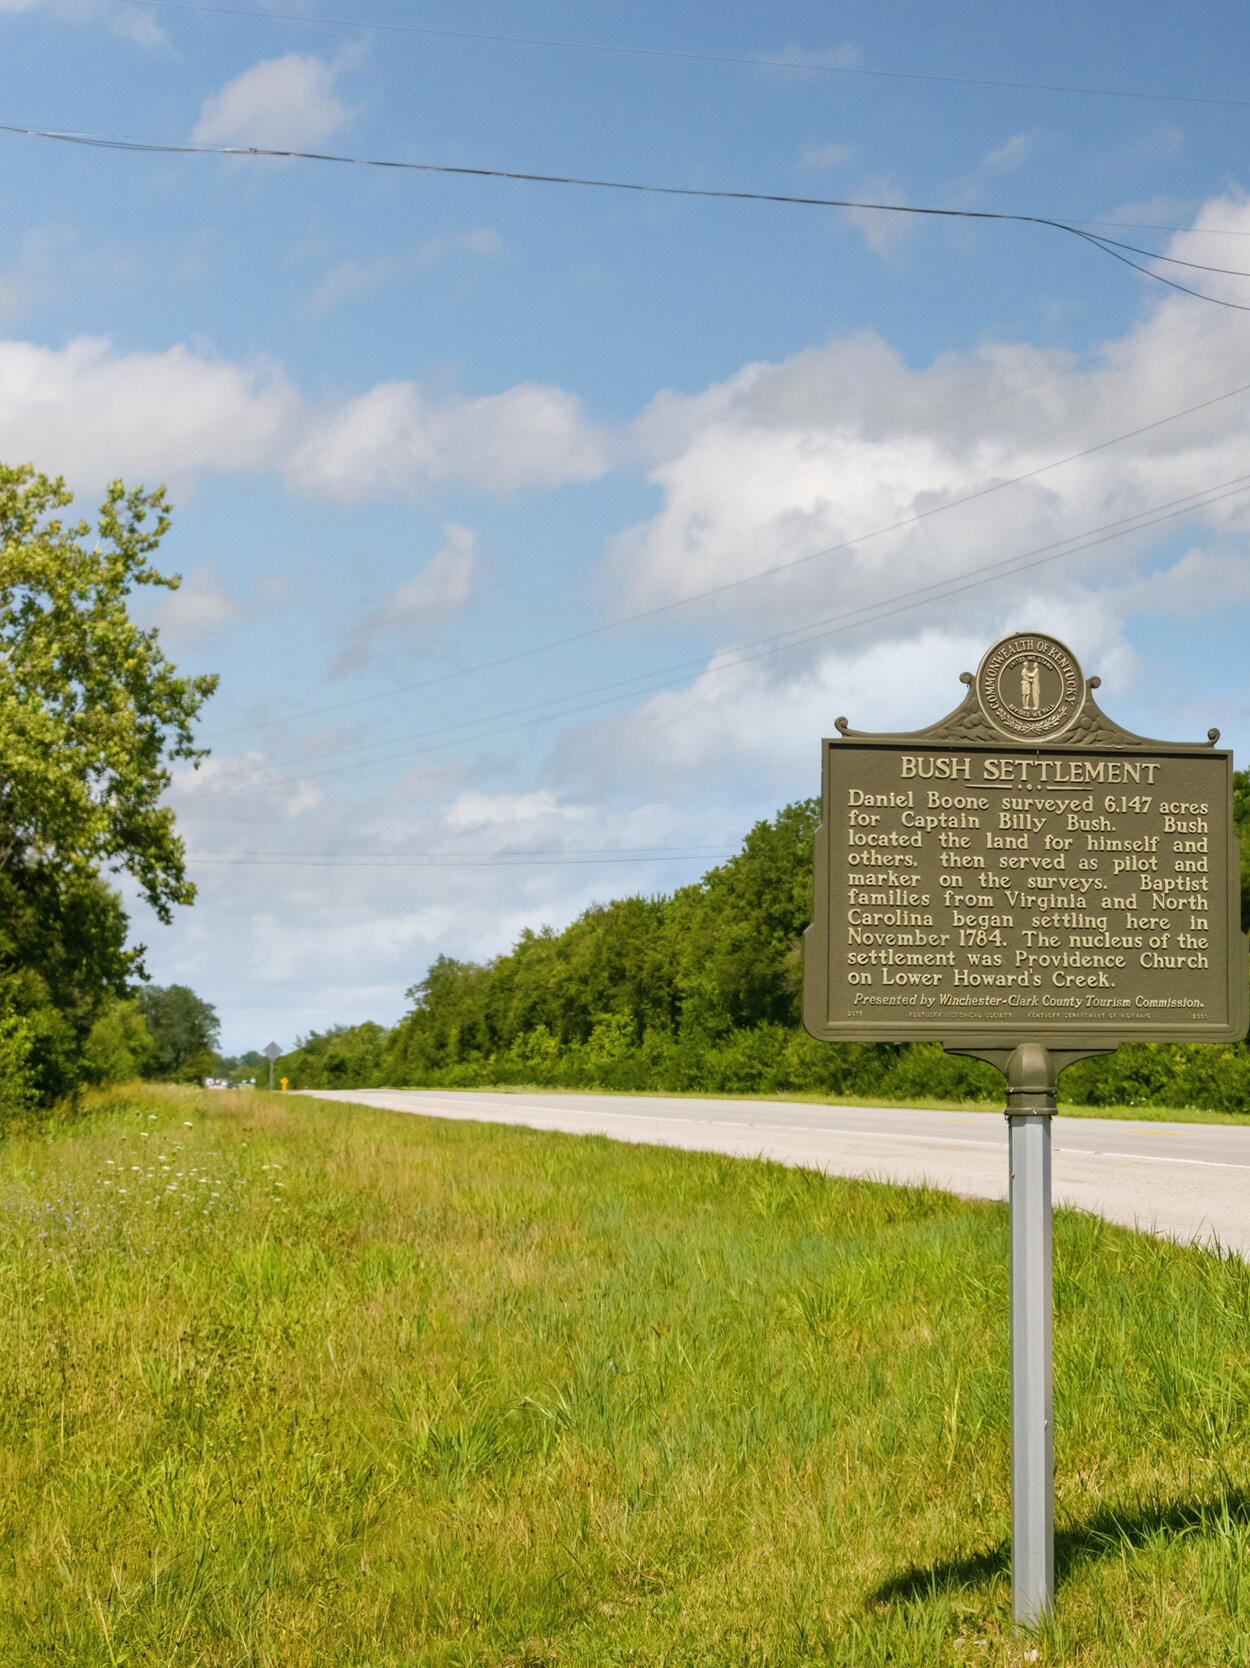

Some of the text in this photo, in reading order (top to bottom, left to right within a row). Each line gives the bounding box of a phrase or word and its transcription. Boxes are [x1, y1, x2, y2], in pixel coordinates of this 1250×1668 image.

[985, 640, 1077, 710] COMMONWEALTH OF KENTUCKY
[900, 756, 1160, 785] BUSH SETTLEMENT
[847, 788, 914, 808] Daniel
[927, 791, 990, 810] Boone
[1001, 797, 1094, 814] surveyed
[1159, 801, 1209, 815] acres
[848, 809, 1209, 834] for Captain Billy Bush. Bush
[847, 829, 1209, 853] located the land for himself and
[939, 852, 985, 869] then
[999, 853, 1065, 870] served
[1078, 858, 1098, 870] as
[1113, 855, 1158, 875] pilot
[1174, 856, 1209, 873] and
[847, 870, 1209, 893] marker on the surveys. Baptist
[847, 888, 1209, 911] families from Virginia and North
[847, 908, 1209, 932] Carolina began settling here in
[847, 927, 1209, 950] November 1784. The nucleus of the
[847, 949, 1209, 970] settlement was Providence Church
[847, 968, 1116, 988] on Lower Howard's Creek.
[853, 993, 1204, 1008] Presented by Winchester-Clark County Tourism Commission.
